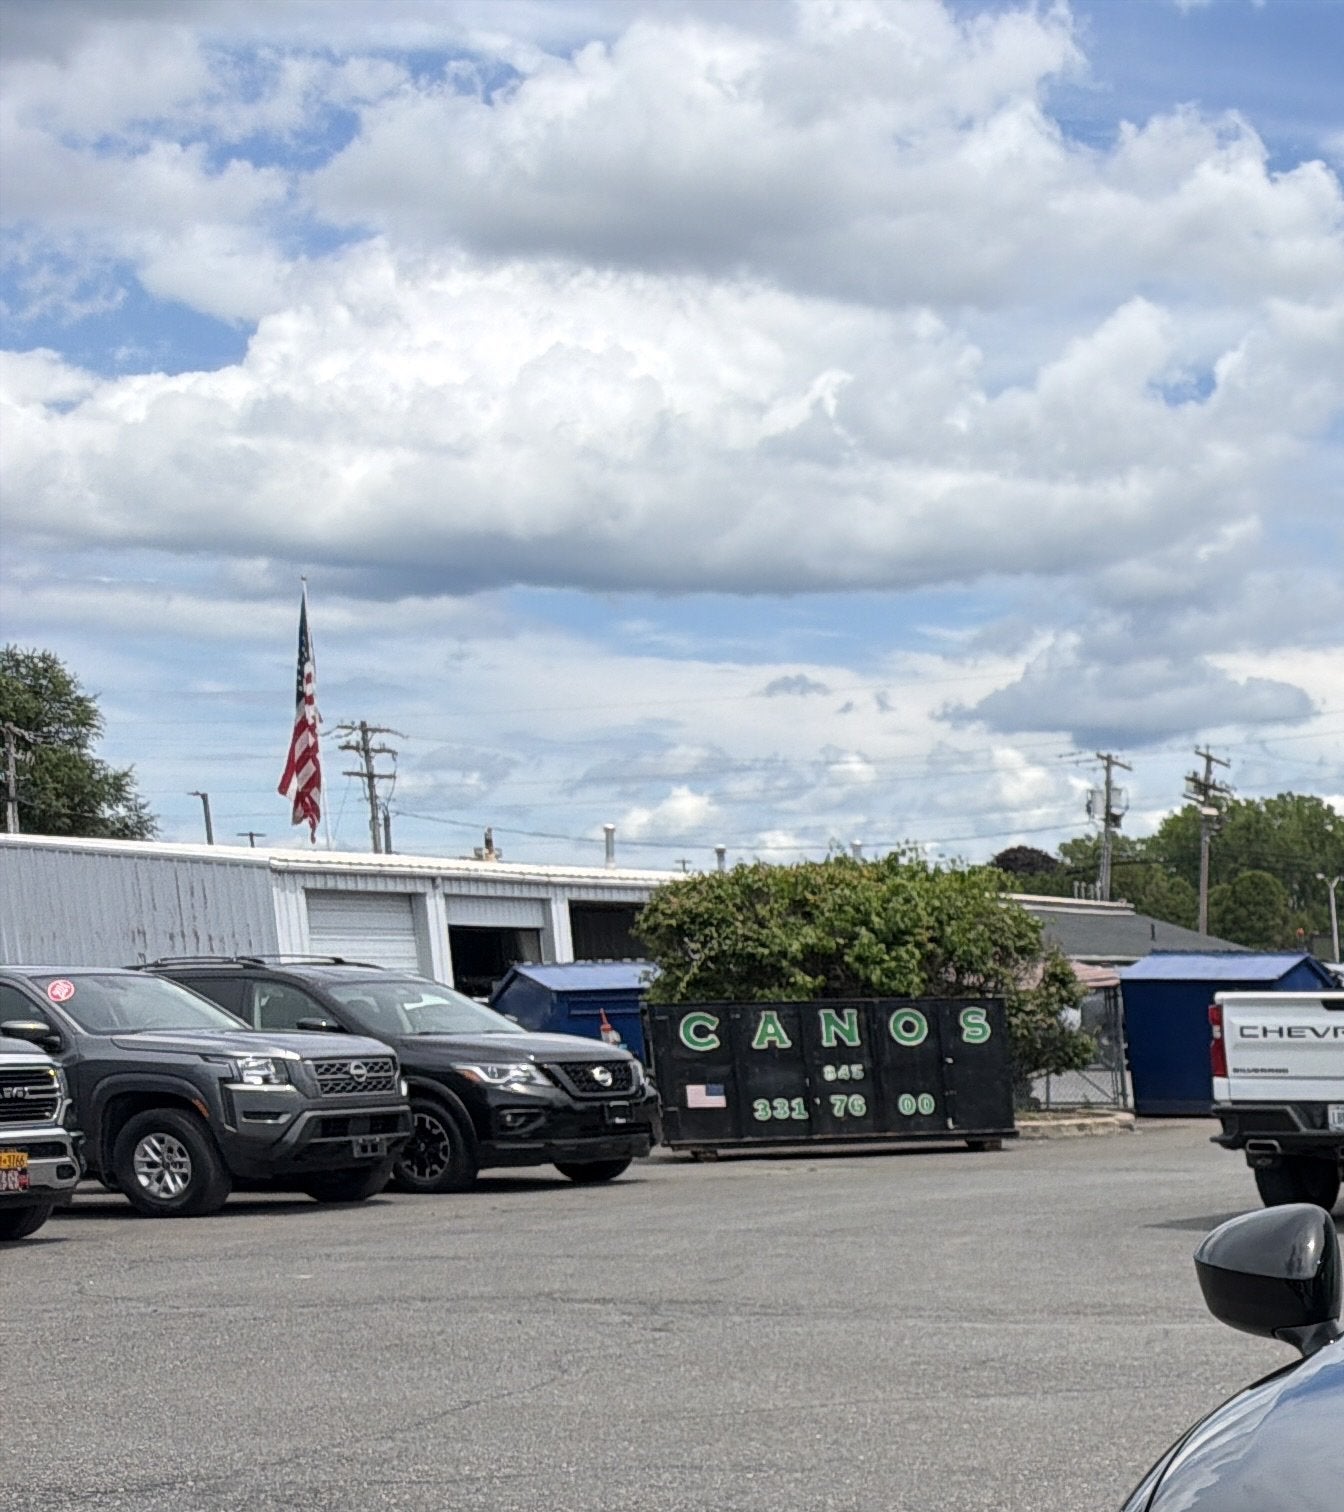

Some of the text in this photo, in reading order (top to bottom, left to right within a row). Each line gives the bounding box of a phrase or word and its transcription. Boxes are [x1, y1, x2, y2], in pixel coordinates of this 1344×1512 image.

[679, 1006, 992, 1051] CANOS
[822, 1064, 864, 1082] 845
[753, 1093, 936, 1121] 331 76 00
